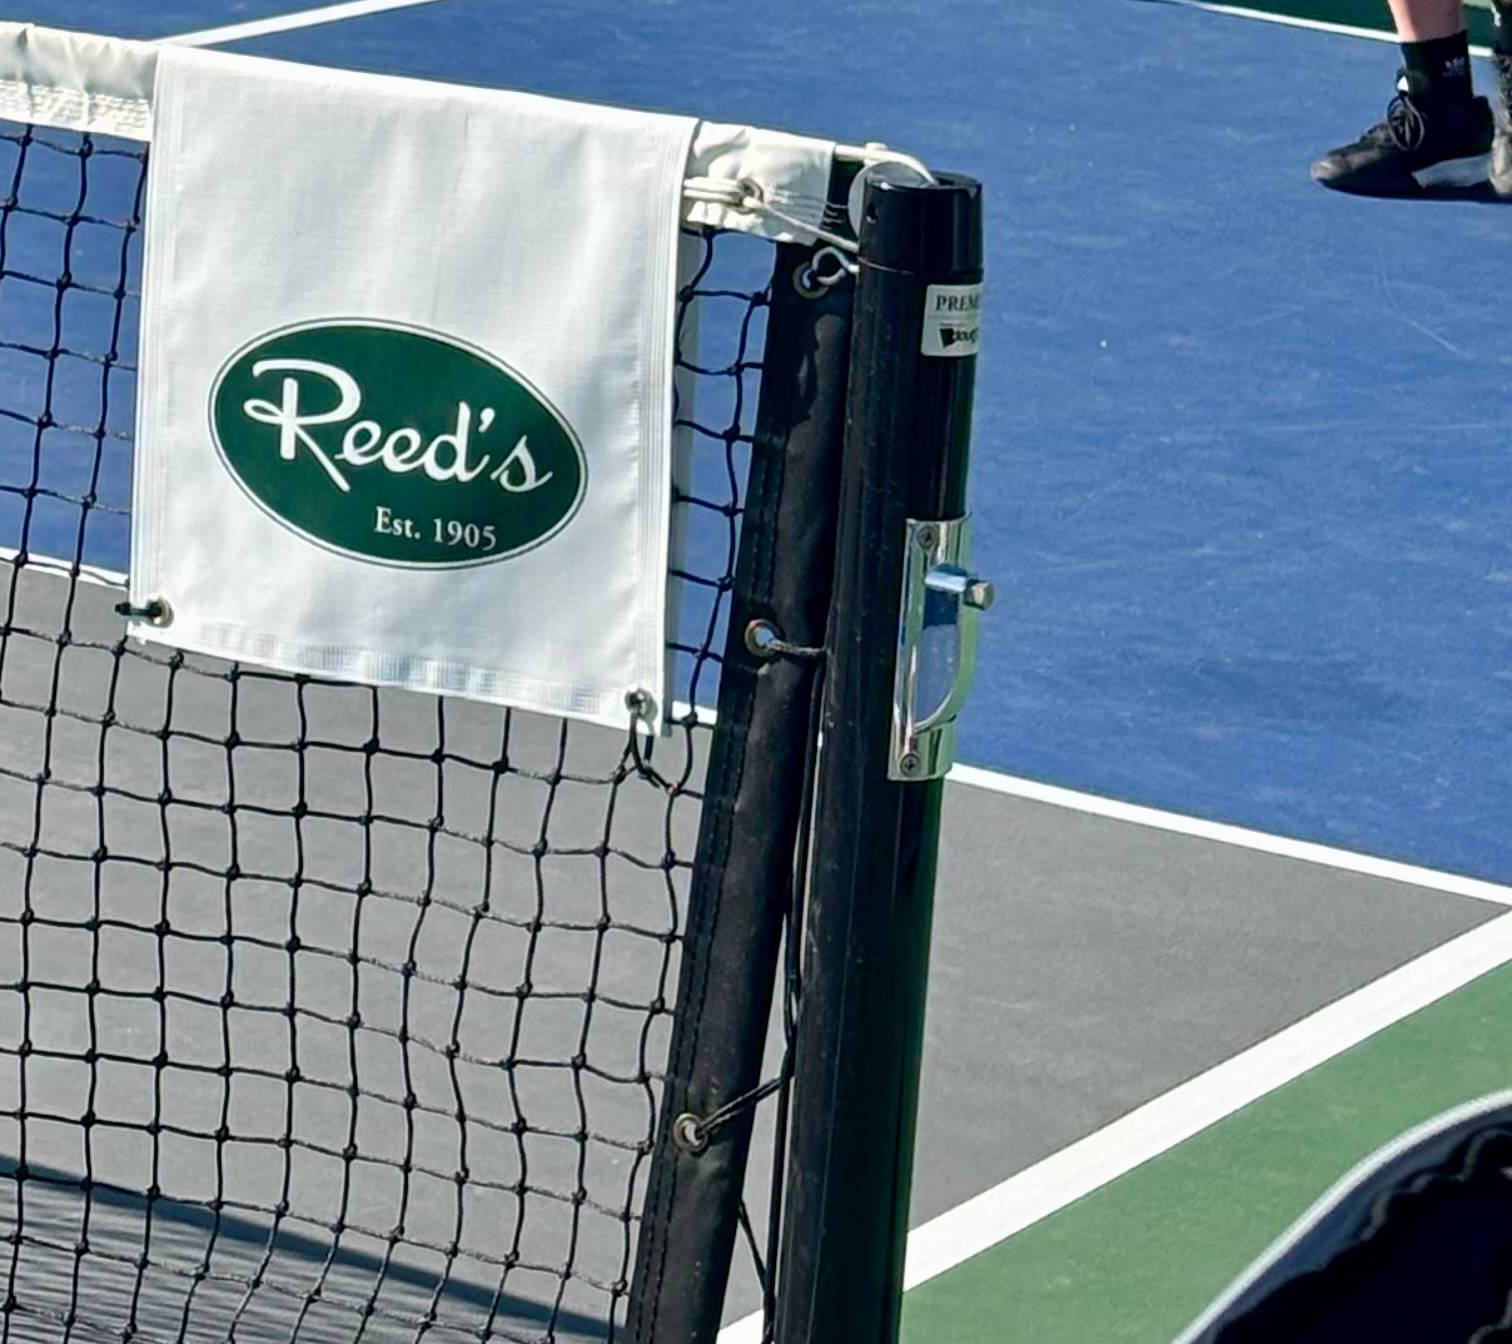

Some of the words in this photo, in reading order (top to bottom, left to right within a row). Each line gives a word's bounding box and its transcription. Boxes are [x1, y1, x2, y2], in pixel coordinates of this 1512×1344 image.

[243, 358, 553, 493] Reed's
[375, 505, 420, 539] Est.
[432, 517, 497, 551] 1905
